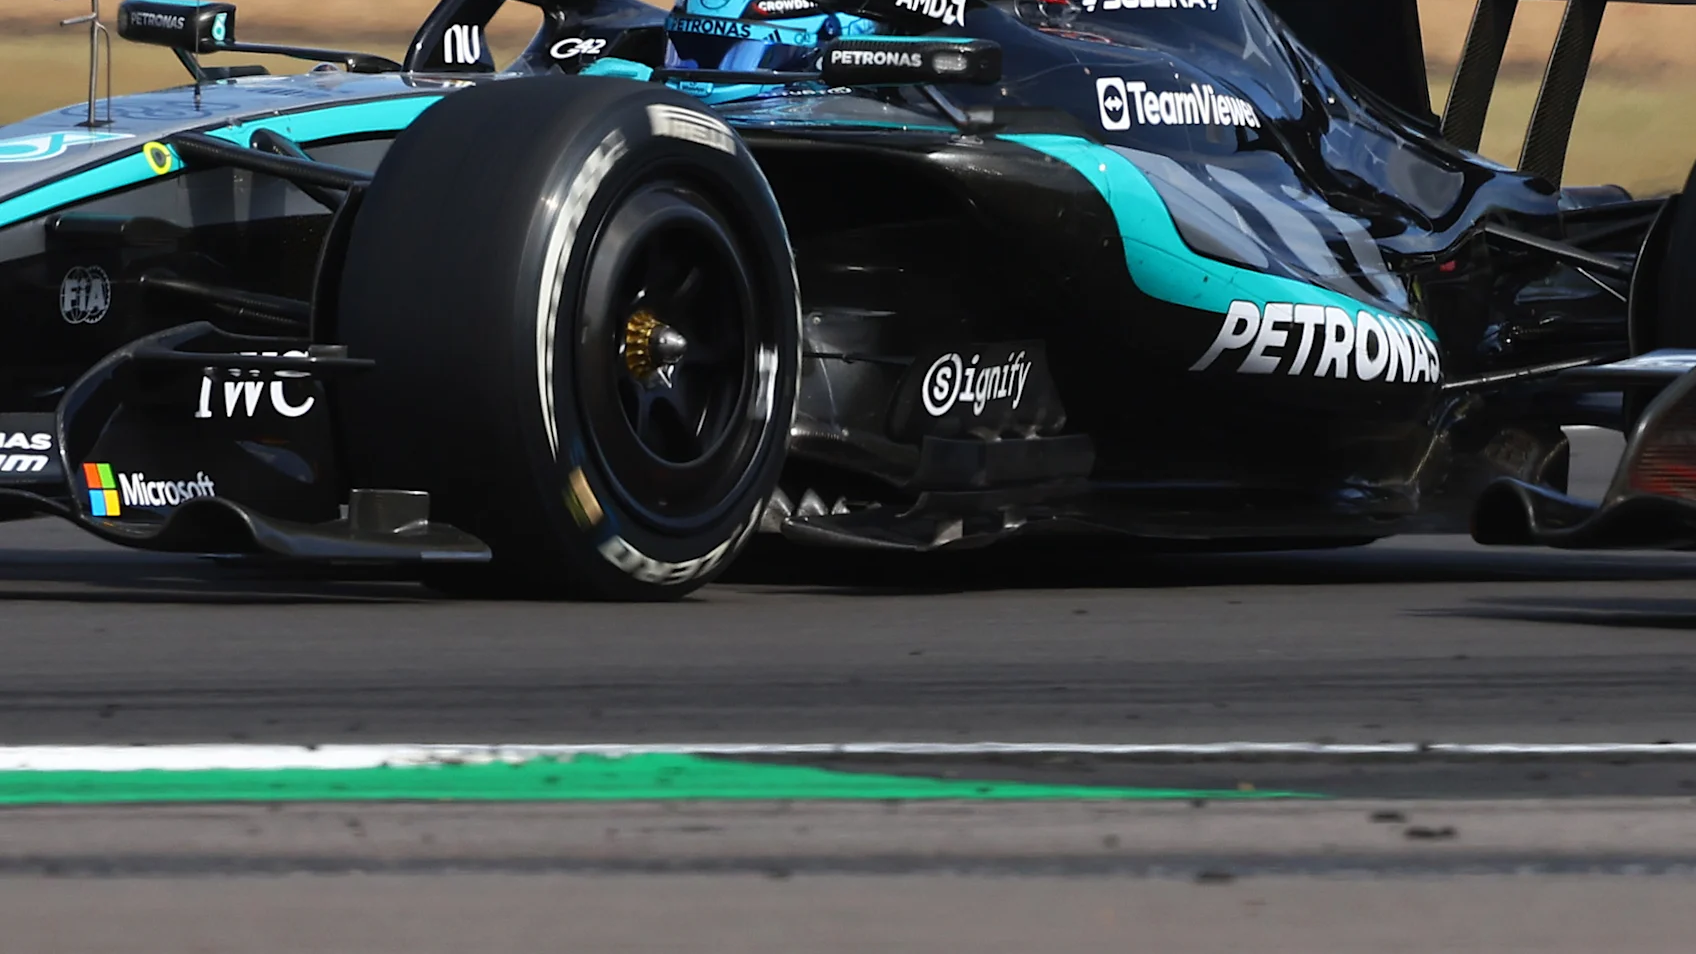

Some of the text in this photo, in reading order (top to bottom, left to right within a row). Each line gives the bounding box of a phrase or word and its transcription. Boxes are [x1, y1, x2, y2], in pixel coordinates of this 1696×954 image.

[130, 11, 185, 29] PETRONAS
[669, 16, 751, 38] PETRONAS
[831, 49, 922, 67] PETRONAS
[1126, 80, 1261, 129] TeamViewer
[1188, 299, 1442, 383] PETRONAS
[118, 472, 215, 507] Microsoft
